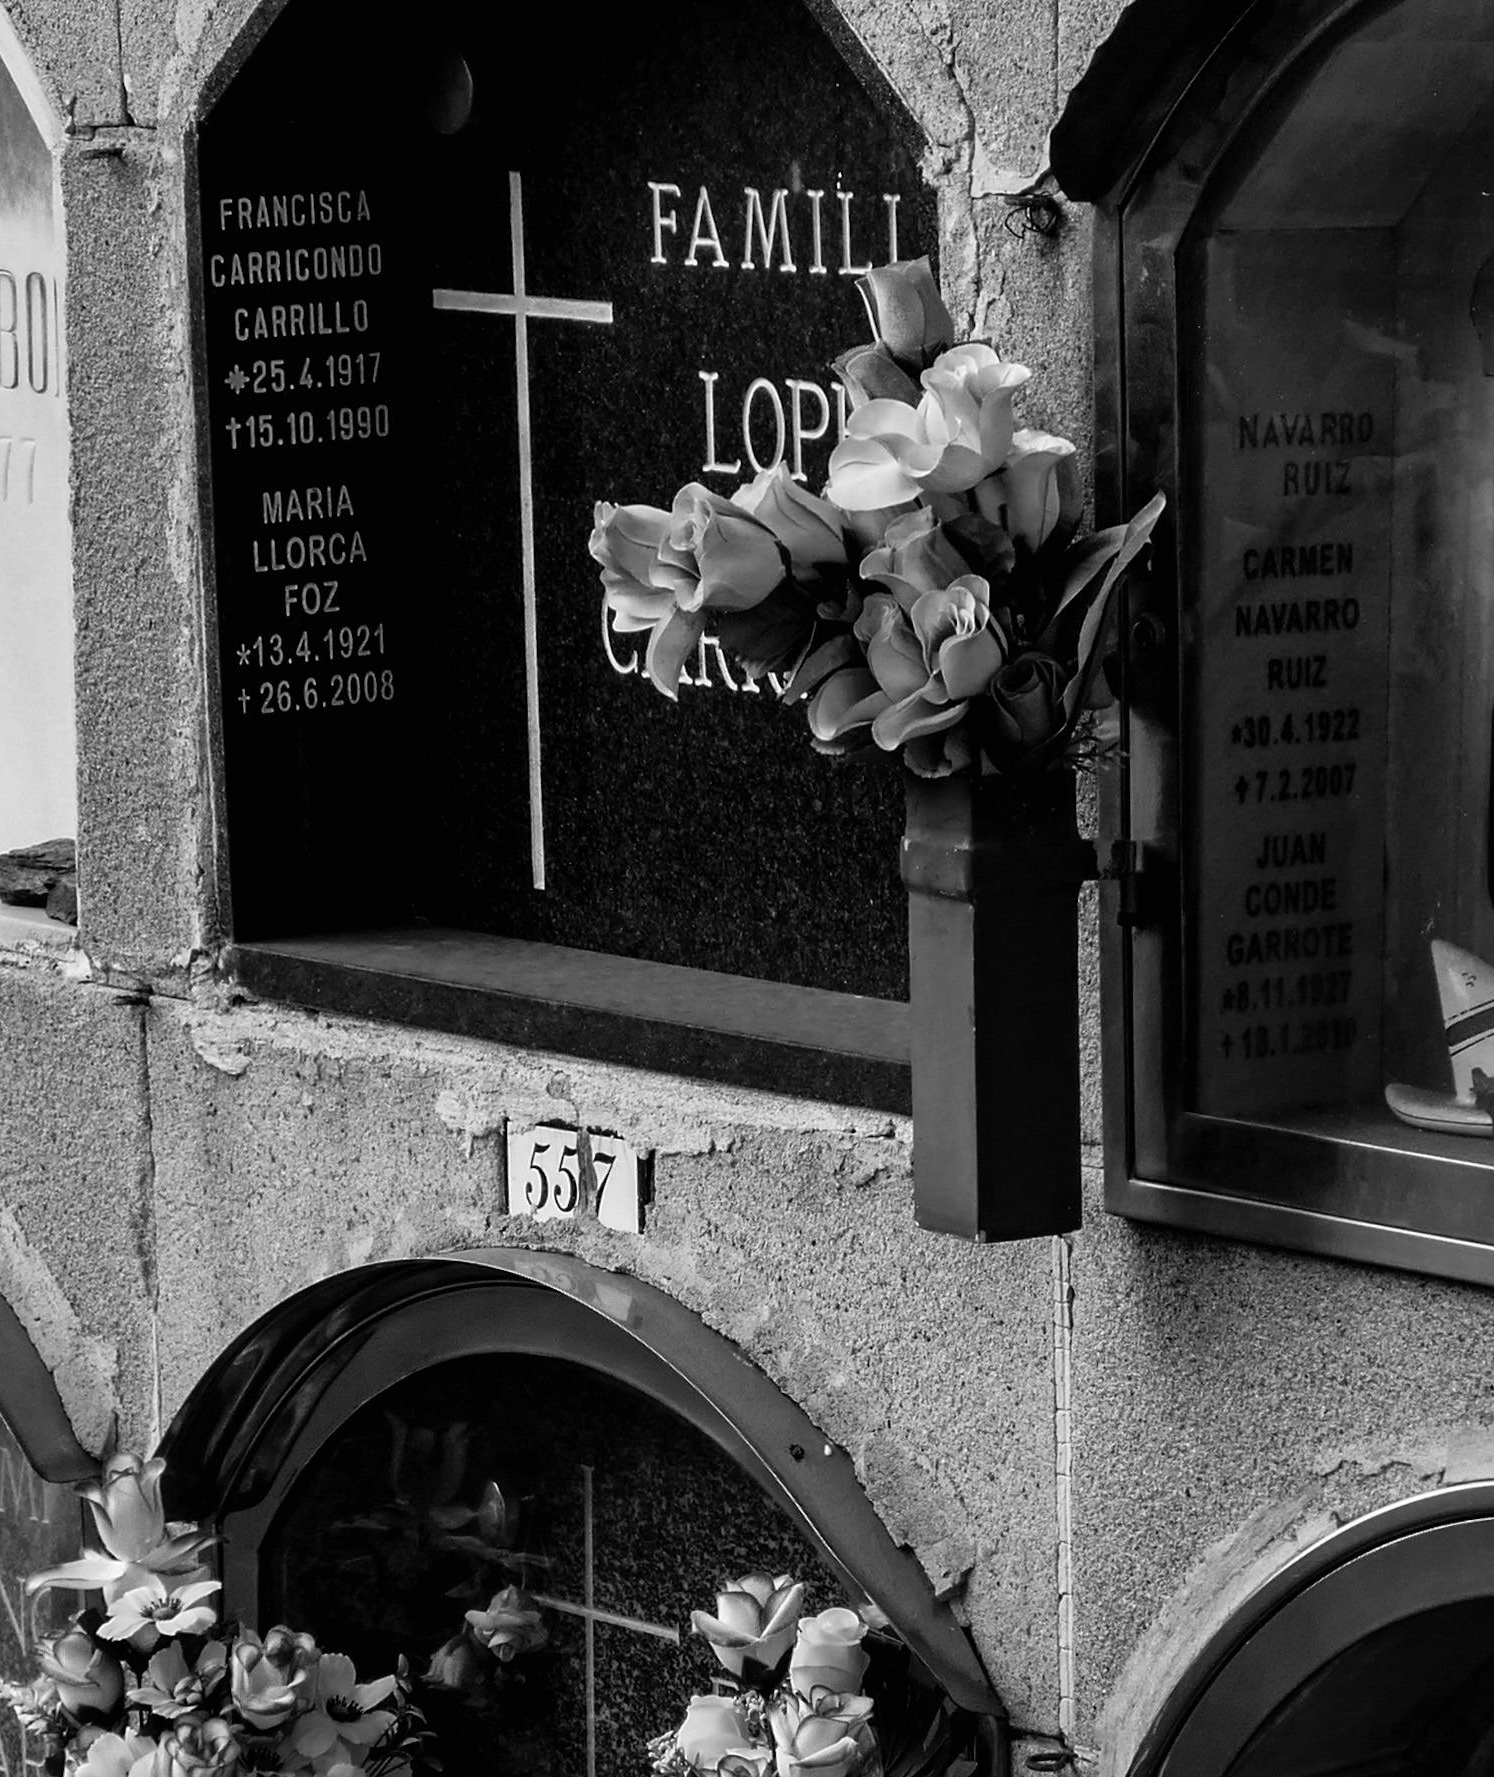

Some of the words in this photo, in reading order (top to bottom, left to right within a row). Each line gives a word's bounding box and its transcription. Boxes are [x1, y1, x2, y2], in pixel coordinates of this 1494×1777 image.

[219, 189, 371, 231] FRANCISCA
[210, 242, 383, 288] CARRICONDO
[234, 299, 370, 341] CARRILLO
[1238, 411, 1375, 450] NAVARRO
[1282, 460, 1352, 497] RUIZ
[261, 483, 355, 525] MARIA
[252, 530, 368, 574] LLORCA
[1243, 543, 1354, 582] CARMEN
[283, 580, 342, 618] FOZ
[1235, 598, 1361, 638] NAVARRO
[1267, 655, 1328, 692] RUIZ
[1257, 832, 1326, 870] JUAN
[1244, 878, 1337, 919] CONDE
[1226, 923, 1354, 968] GARROTE
[526, 1144, 617, 1224] 557
